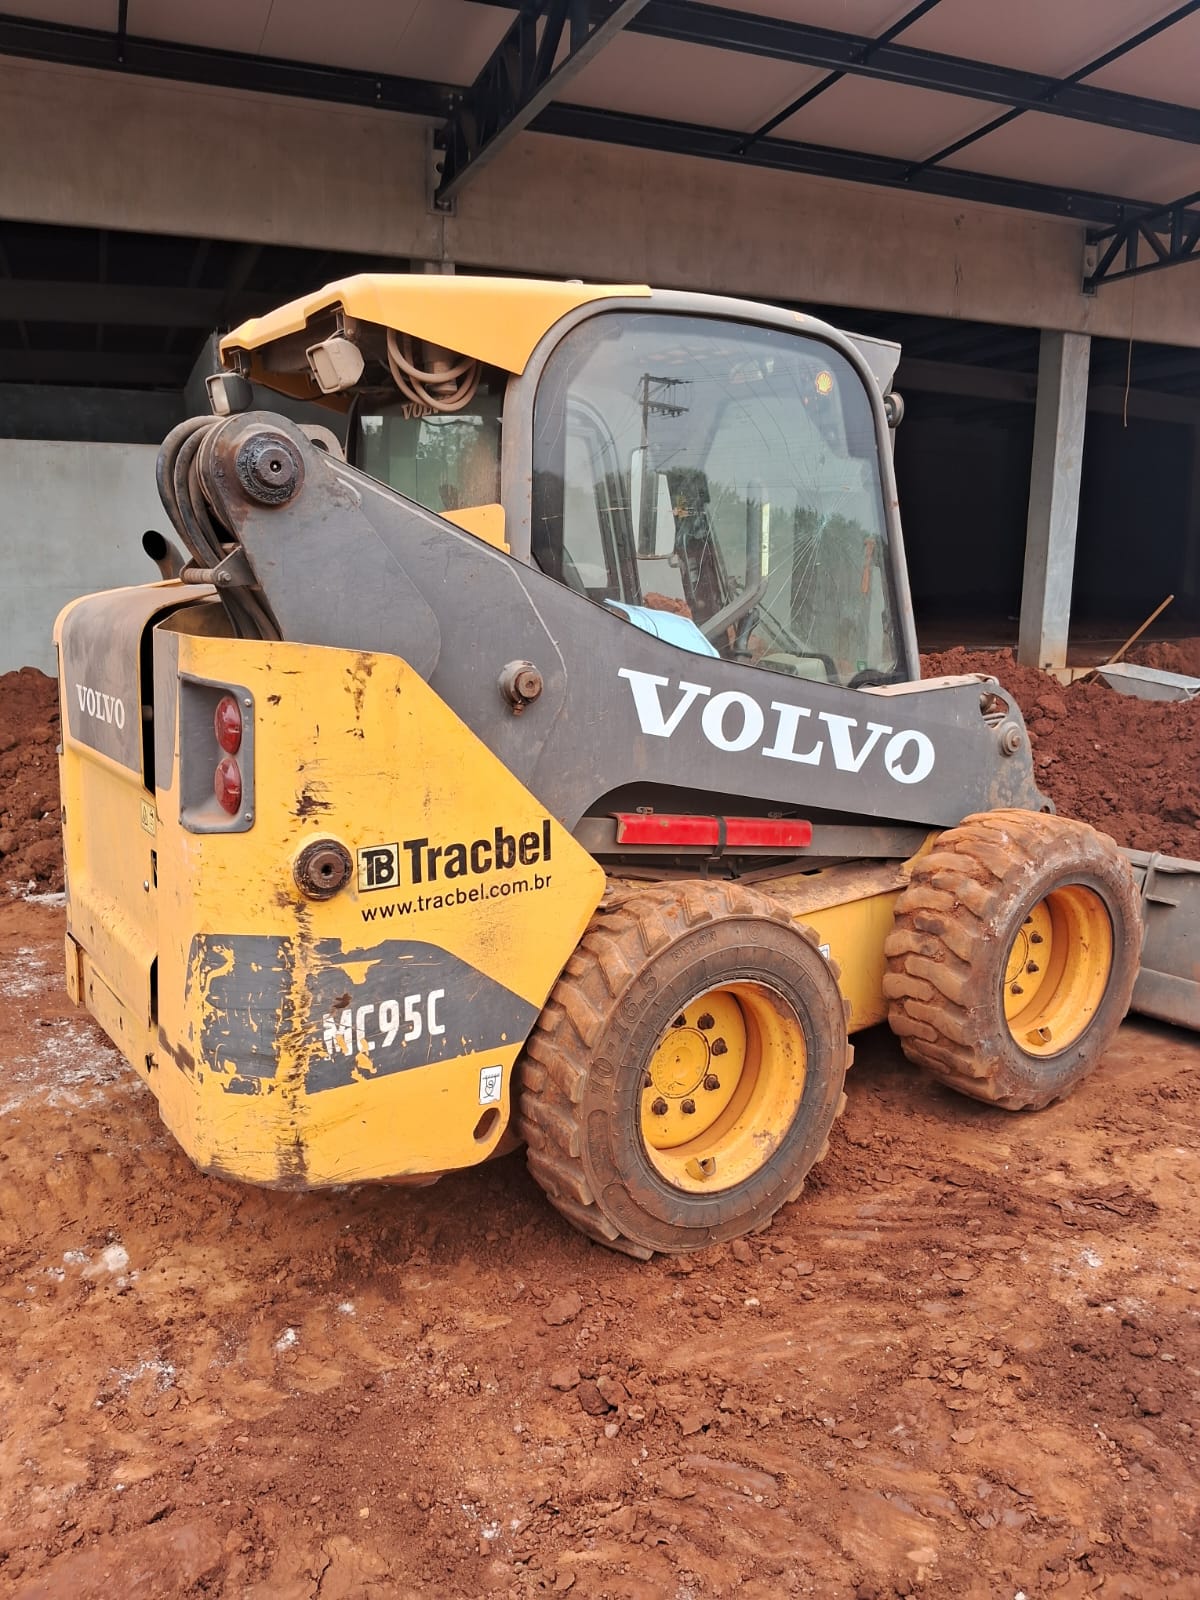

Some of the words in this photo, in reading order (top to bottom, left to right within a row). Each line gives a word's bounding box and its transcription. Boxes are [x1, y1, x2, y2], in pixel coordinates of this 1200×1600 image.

[401, 402, 440, 420] VOL
[75, 683, 125, 729] VOLVO
[617, 667, 936, 784] VOLVO
[403, 819, 551, 884] Tracbel
[361, 873, 552, 922] www.tracbel.com.br
[322, 988, 446, 1058] MC95C
